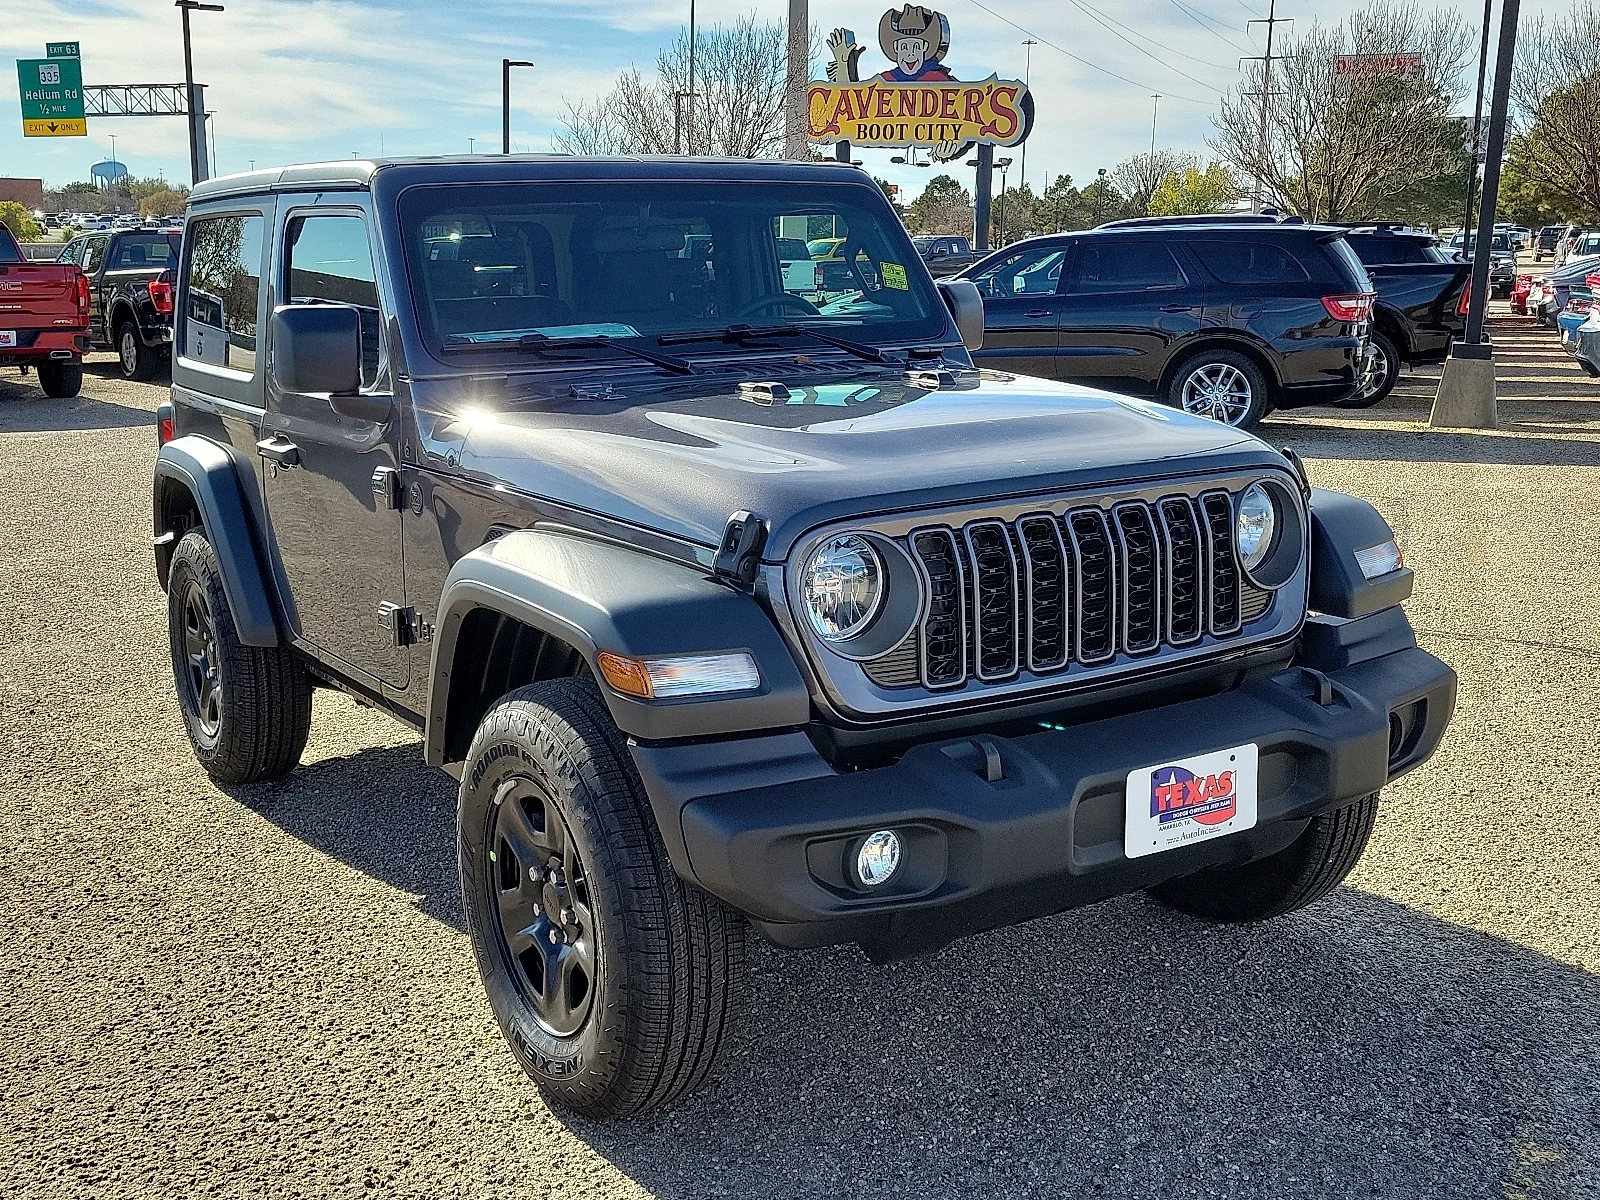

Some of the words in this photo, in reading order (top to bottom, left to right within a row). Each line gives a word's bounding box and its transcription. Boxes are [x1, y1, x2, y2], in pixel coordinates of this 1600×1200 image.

[49, 46, 63, 54] EXIT
[65, 44, 77, 54] 63
[40, 71, 59, 83] 335
[25, 89, 60, 100] Helium
[64, 88, 78, 99] Rd
[52, 105, 67, 113] MILE
[807, 82, 1019, 138] CAVENDER'S
[29, 124, 45, 132] EXIT
[60, 123, 80, 131] ONLY
[856, 123, 909, 141] BOOT
[914, 122, 964, 141] CITY
[472, 742, 520, 787] ROADIAN
[1155, 770, 1233, 812] TEXAS
[513, 1027, 579, 1076] NEXEN
